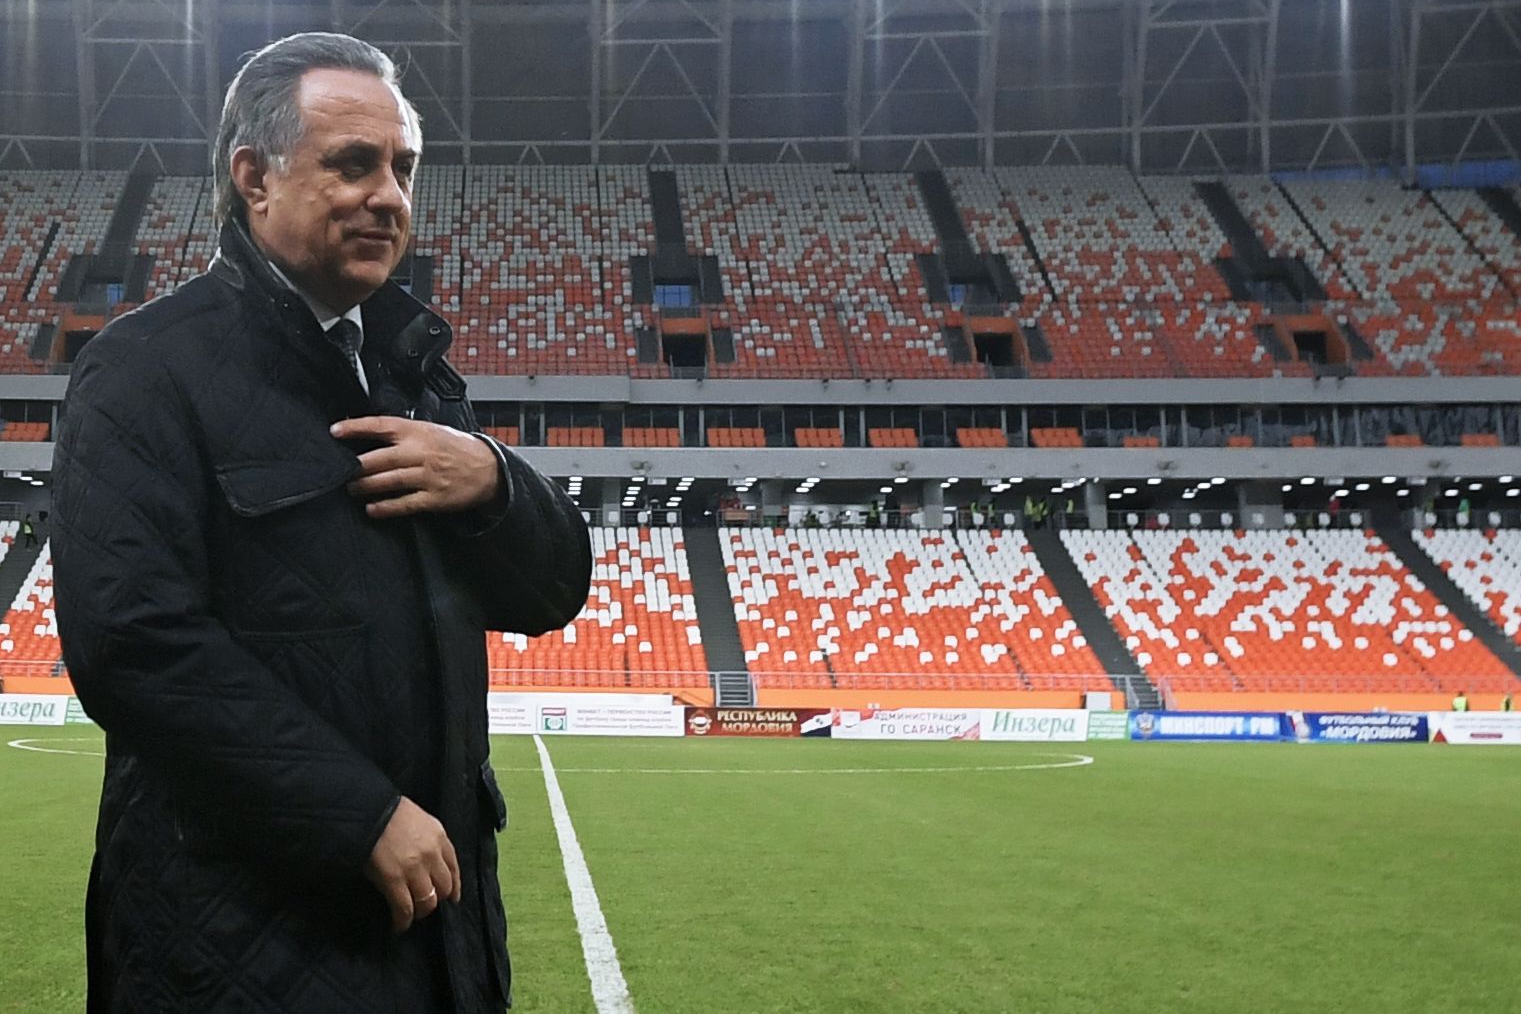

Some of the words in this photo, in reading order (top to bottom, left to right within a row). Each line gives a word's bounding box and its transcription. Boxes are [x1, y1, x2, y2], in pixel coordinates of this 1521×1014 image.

[717, 710, 797, 722] РЕСПУБЛИКА
[874, 711, 968, 722] АДМИНИСТРАЦИЯ
[721, 722, 793, 734] МОРДОВИЯ
[880, 723, 896, 735] ГО
[902, 723, 962, 735] САРАНСК
[992, 711, 1077, 738] Инзера
